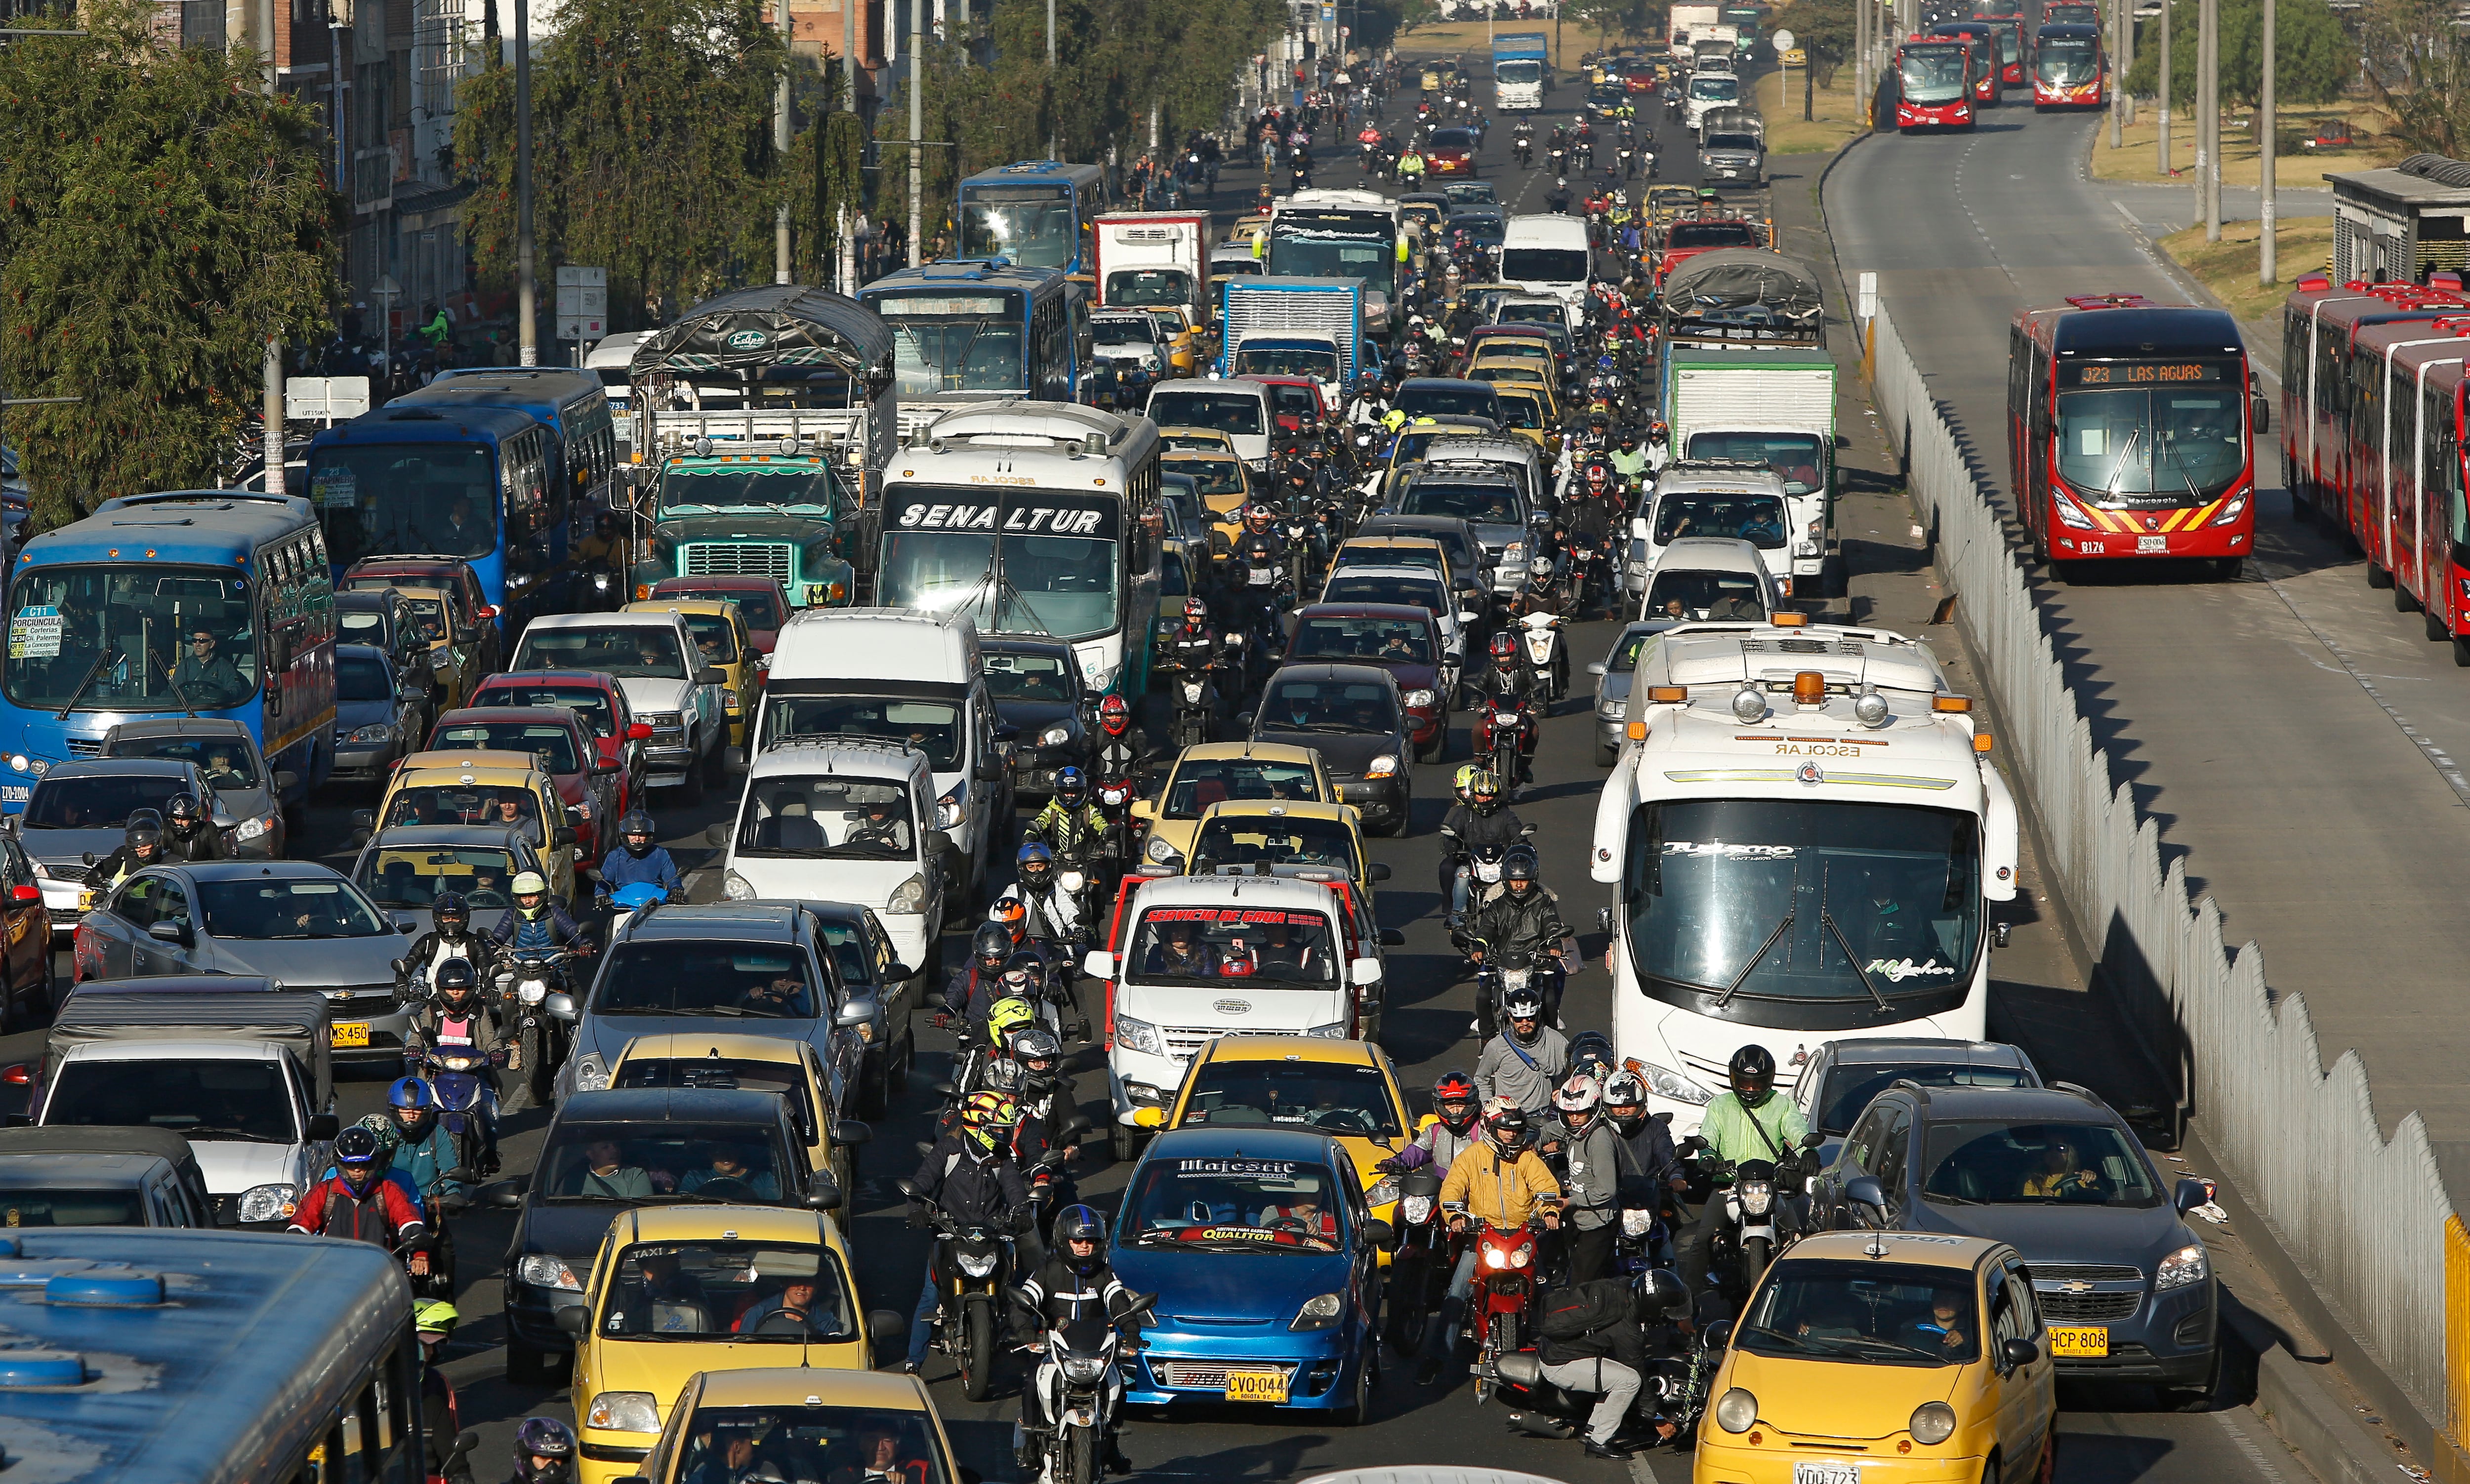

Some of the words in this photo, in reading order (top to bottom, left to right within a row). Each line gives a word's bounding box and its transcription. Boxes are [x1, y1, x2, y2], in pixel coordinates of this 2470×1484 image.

[2083, 367, 2110, 382] J23
[2128, 366, 2155, 382] LAS
[2159, 364, 2203, 381] AGUAS
[899, 503, 997, 529] SENA
[2081, 541, 2104, 552] B176
[31, 607, 53, 617] C11
[13, 617, 62, 628] PORCIÚNCULA
[2, 786, 29, 800] Z70-2004
[1144, 909, 1217, 922] SERVICIO
[1218, 910, 1241, 923] DE
[1243, 910, 1285, 925] GRUA
[348, 1027, 367, 1039] 450
[1180, 1159, 1296, 1173] Majestic
[1202, 1230, 1275, 1242] QUALITOR
[633, 1248, 663, 1258] TAXI
[2051, 1332, 2077, 1347] HCP
[2080, 1333, 2105, 1348] 808
[1228, 1376, 1256, 1395] CVQ
[1257, 1376, 1285, 1395] 044
